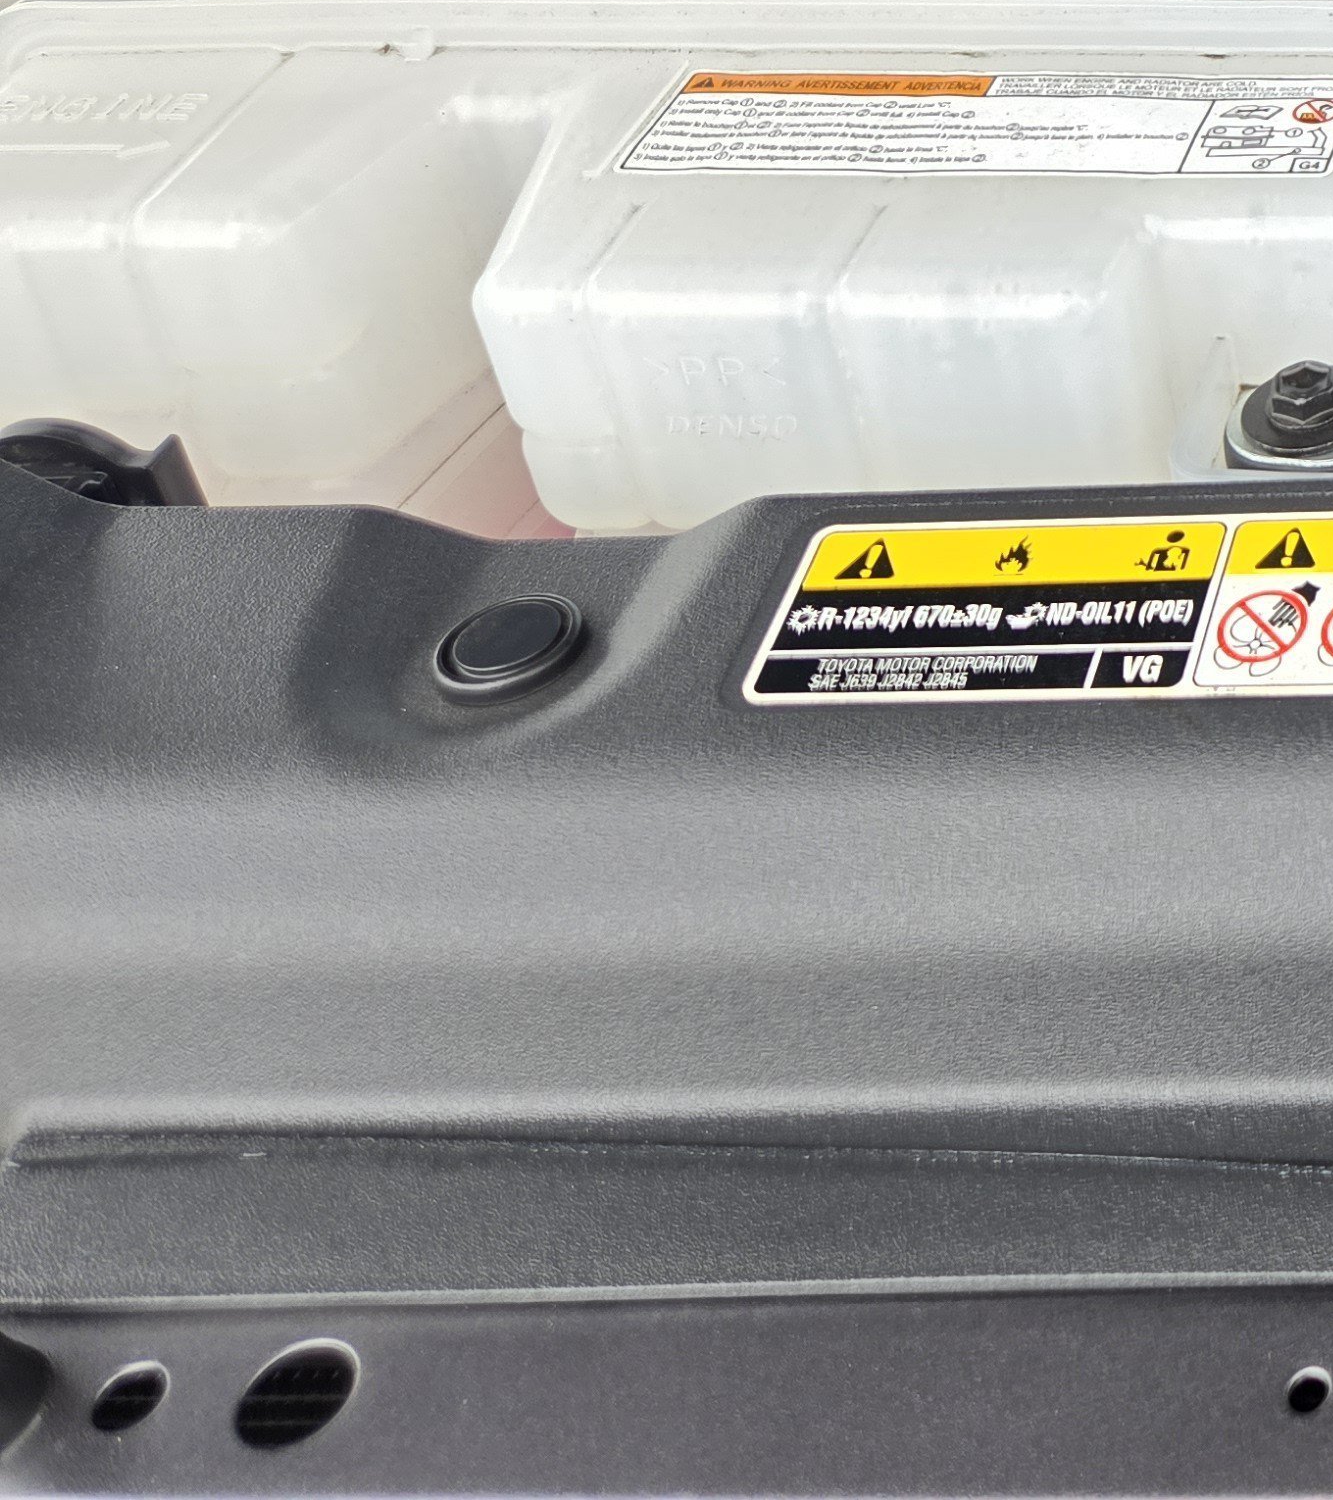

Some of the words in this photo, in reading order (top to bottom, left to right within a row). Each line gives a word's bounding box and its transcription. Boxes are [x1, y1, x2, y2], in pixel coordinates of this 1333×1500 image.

[721, 79, 792, 89] WARNING
[796, 80, 900, 91] AVERTISSEMENT
[903, 82, 981, 91] ADVERTENCIA
[1298, 161, 1321, 170] G4
[819, 605, 914, 633] R-1234yf
[1138, 599, 1195, 628] (POE)
[818, 658, 875, 674] TOYOTA
[875, 657, 932, 674] MOTOR
[930, 655, 1039, 674] CORPORATION
[1122, 654, 1164, 684] VG
[808, 673, 842, 691] SAE
